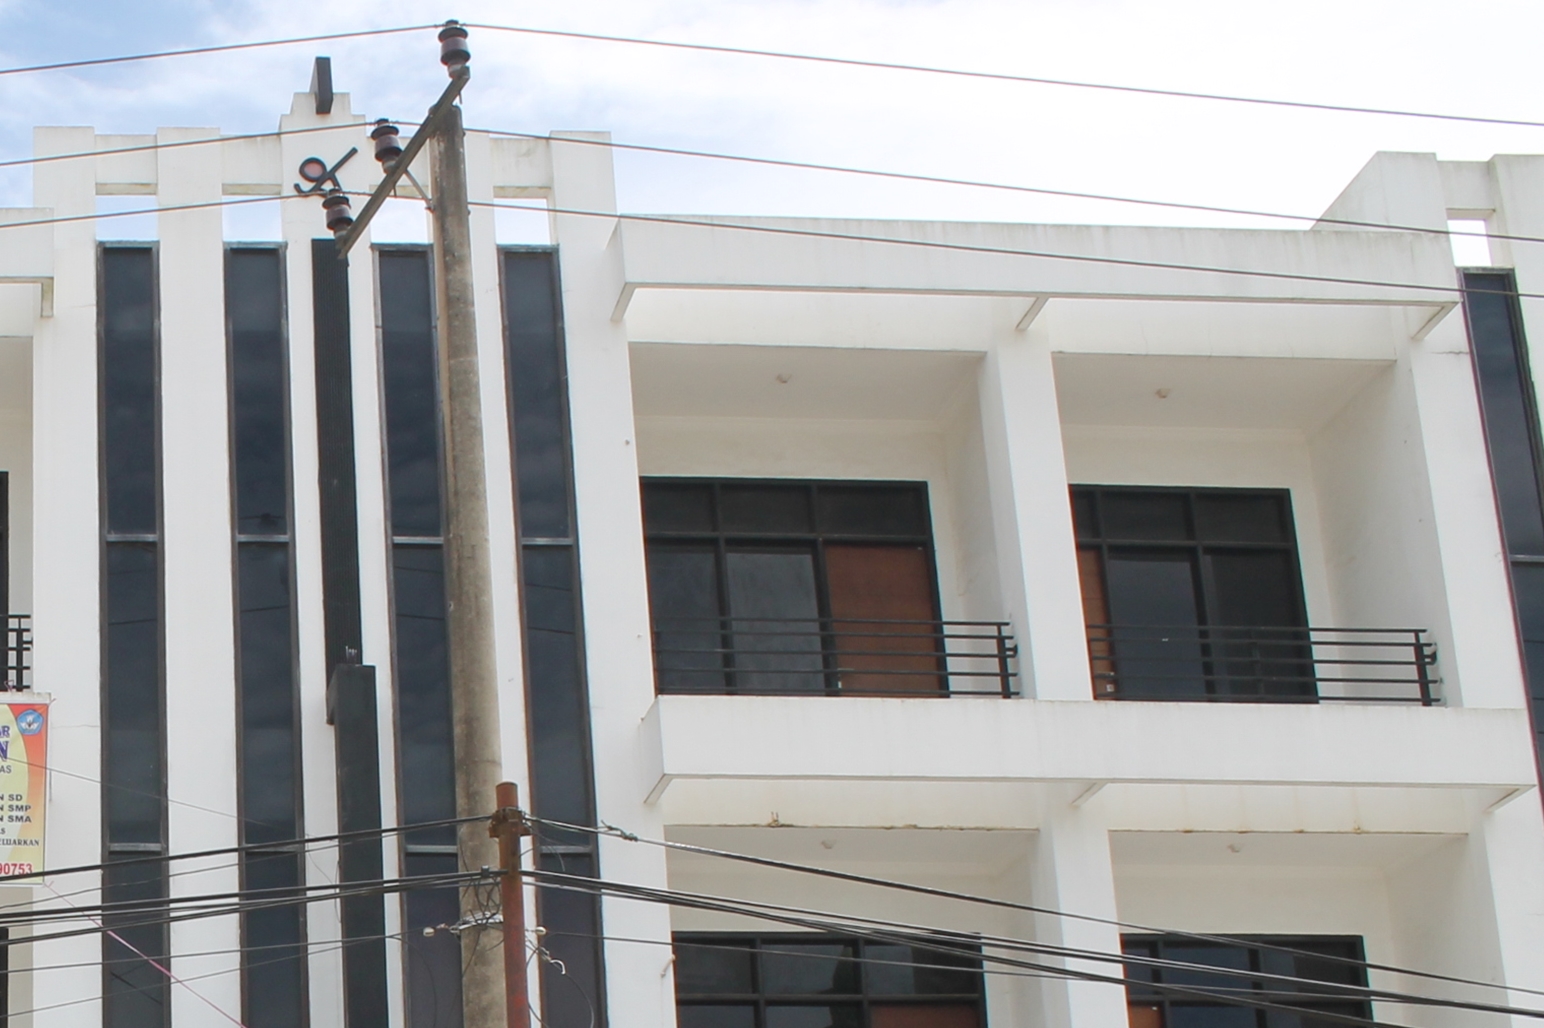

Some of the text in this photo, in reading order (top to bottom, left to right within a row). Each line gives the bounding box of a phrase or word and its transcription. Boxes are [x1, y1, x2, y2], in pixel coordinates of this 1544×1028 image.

[8, 794, 23, 802] SD
[8, 804, 31, 813] SMP
[8, 814, 32, 824] SMA
